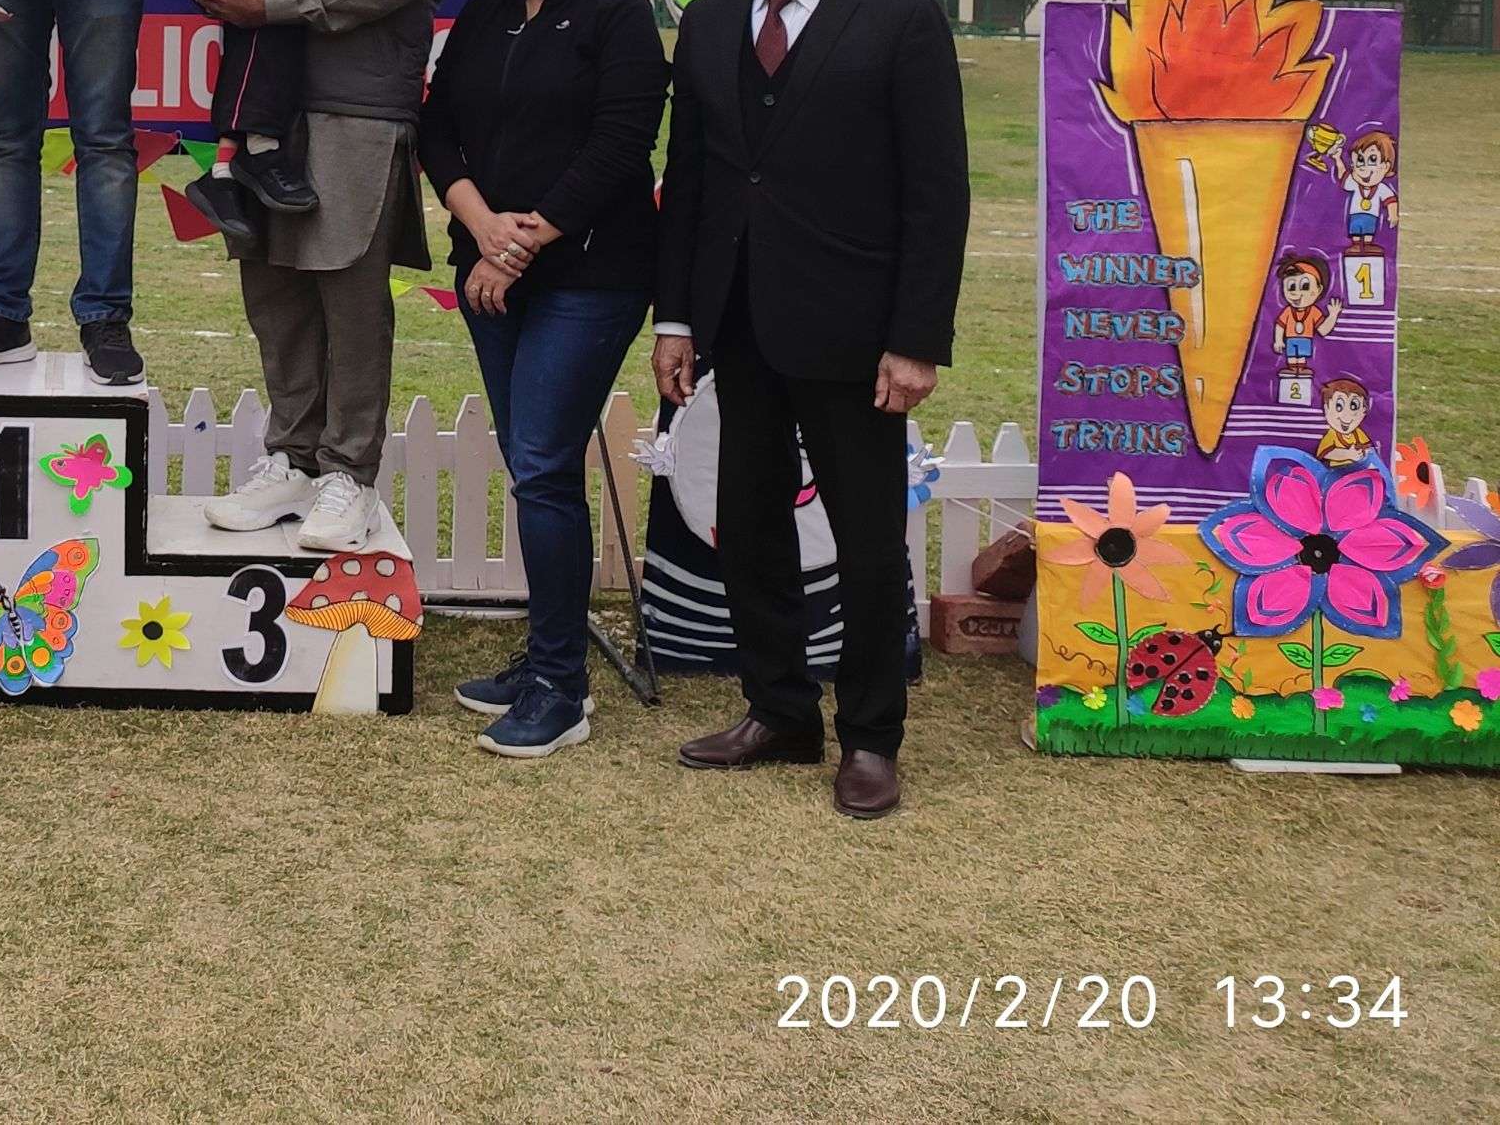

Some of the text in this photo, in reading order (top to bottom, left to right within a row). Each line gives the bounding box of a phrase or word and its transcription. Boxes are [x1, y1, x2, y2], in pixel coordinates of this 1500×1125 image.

[1066, 199, 1143, 233] THE
[1060, 253, 1201, 288] WINNER
[1355, 261, 1373, 300] 1
[1064, 308, 1186, 343] NEVER
[1055, 363, 1182, 401] STOPS
[1289, 381, 1303, 400] 2
[1051, 419, 1188, 457] TRYING
[222, 565, 288, 683] 3
